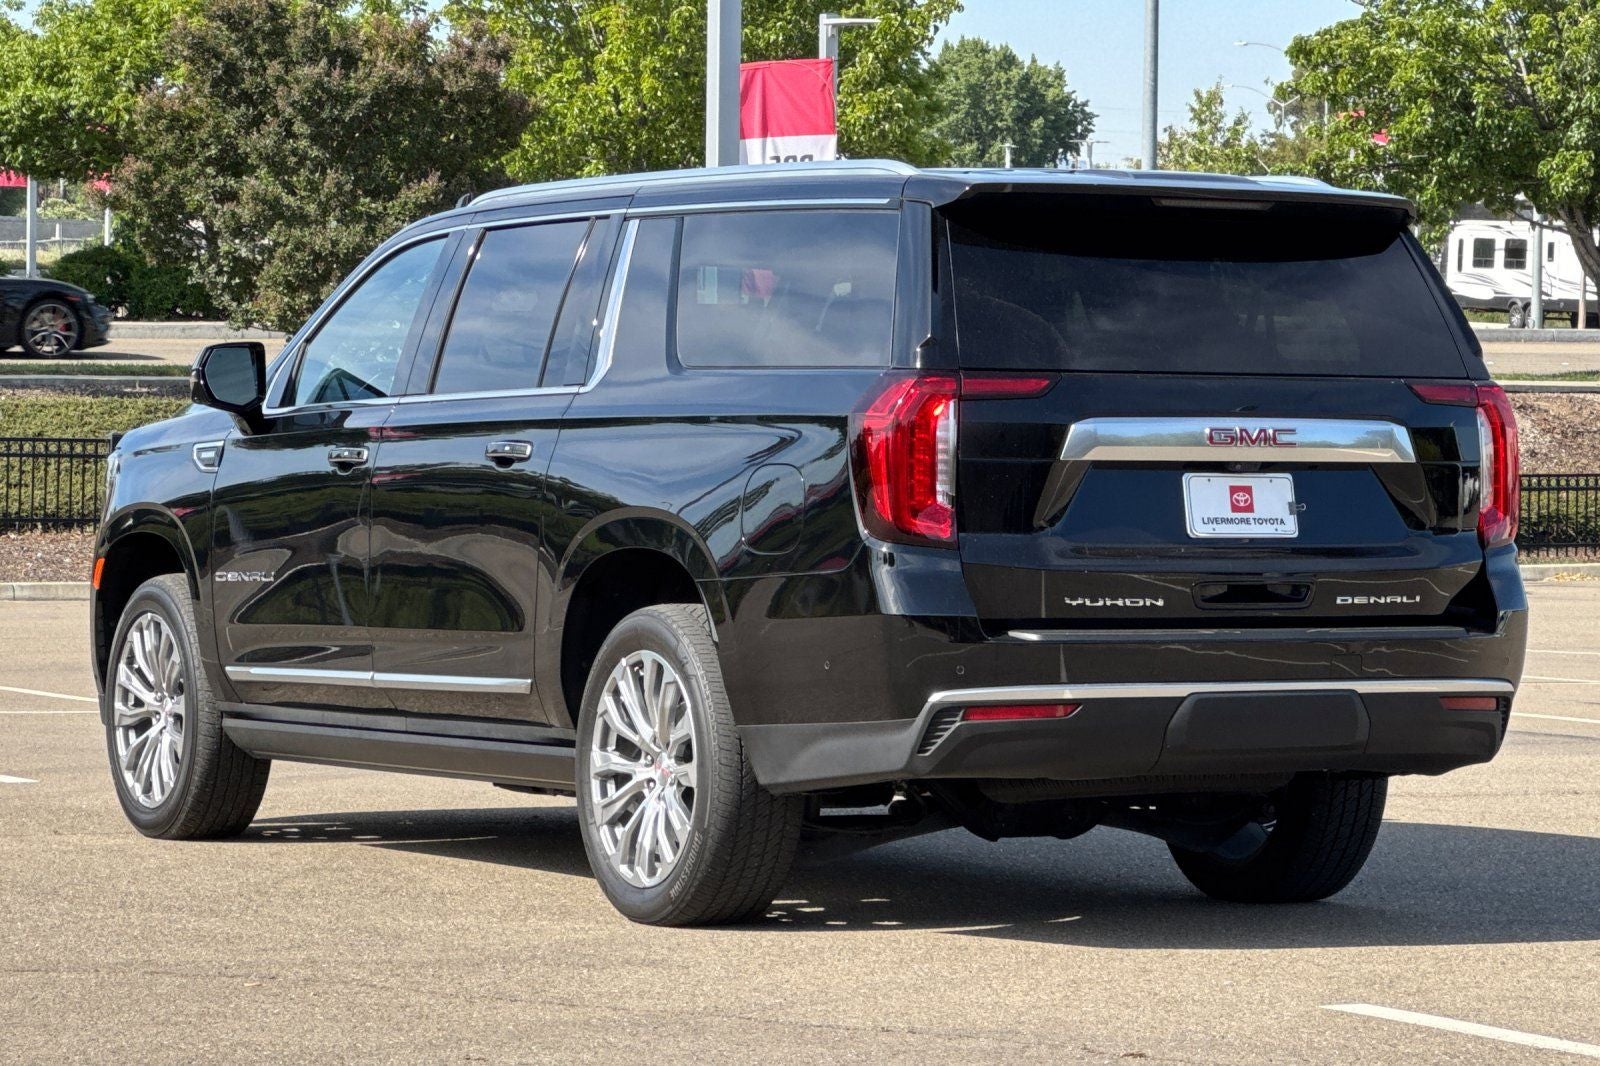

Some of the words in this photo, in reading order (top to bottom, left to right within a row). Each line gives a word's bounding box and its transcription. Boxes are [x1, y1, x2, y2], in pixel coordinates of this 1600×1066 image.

[1204, 427, 1298, 447] GMC
[1201, 517, 1251, 526] LIVERMORE
[1252, 517, 1286, 526] TOYOTA
[215, 571, 275, 582] DENALI
[1064, 597, 1164, 607] YUKON
[1336, 595, 1421, 605] DENALI
